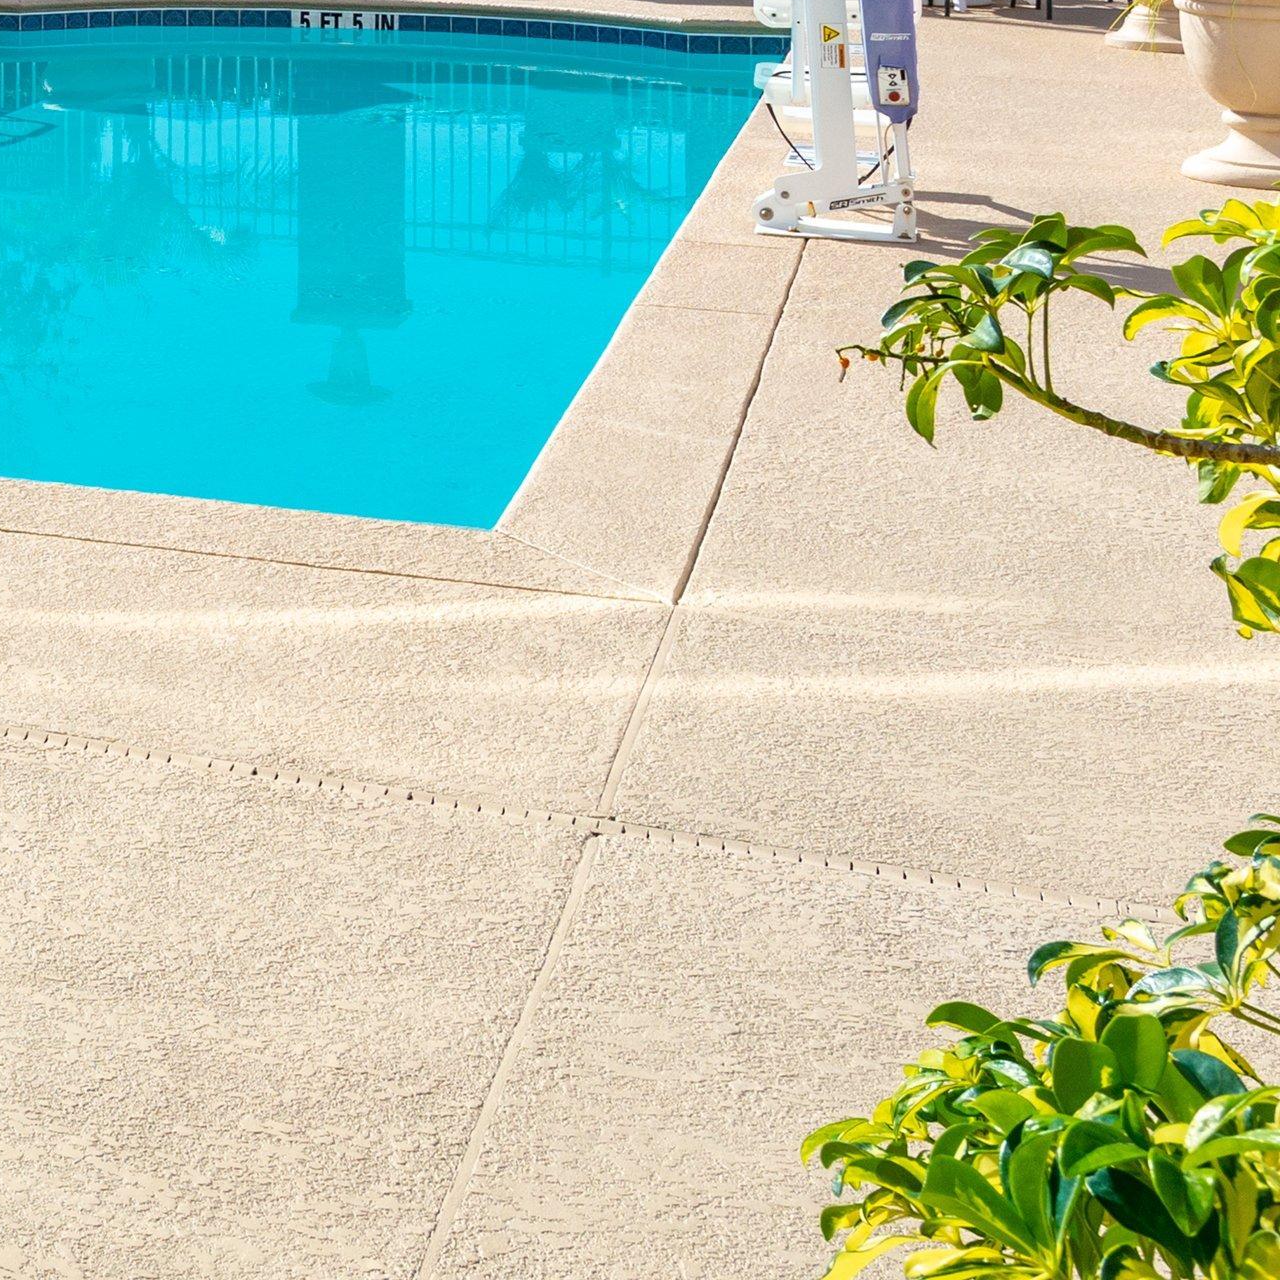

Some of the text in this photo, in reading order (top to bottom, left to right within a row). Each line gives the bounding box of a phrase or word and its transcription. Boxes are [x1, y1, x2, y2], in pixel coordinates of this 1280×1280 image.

[300, 12, 395, 30] 5 FT 5 IN
